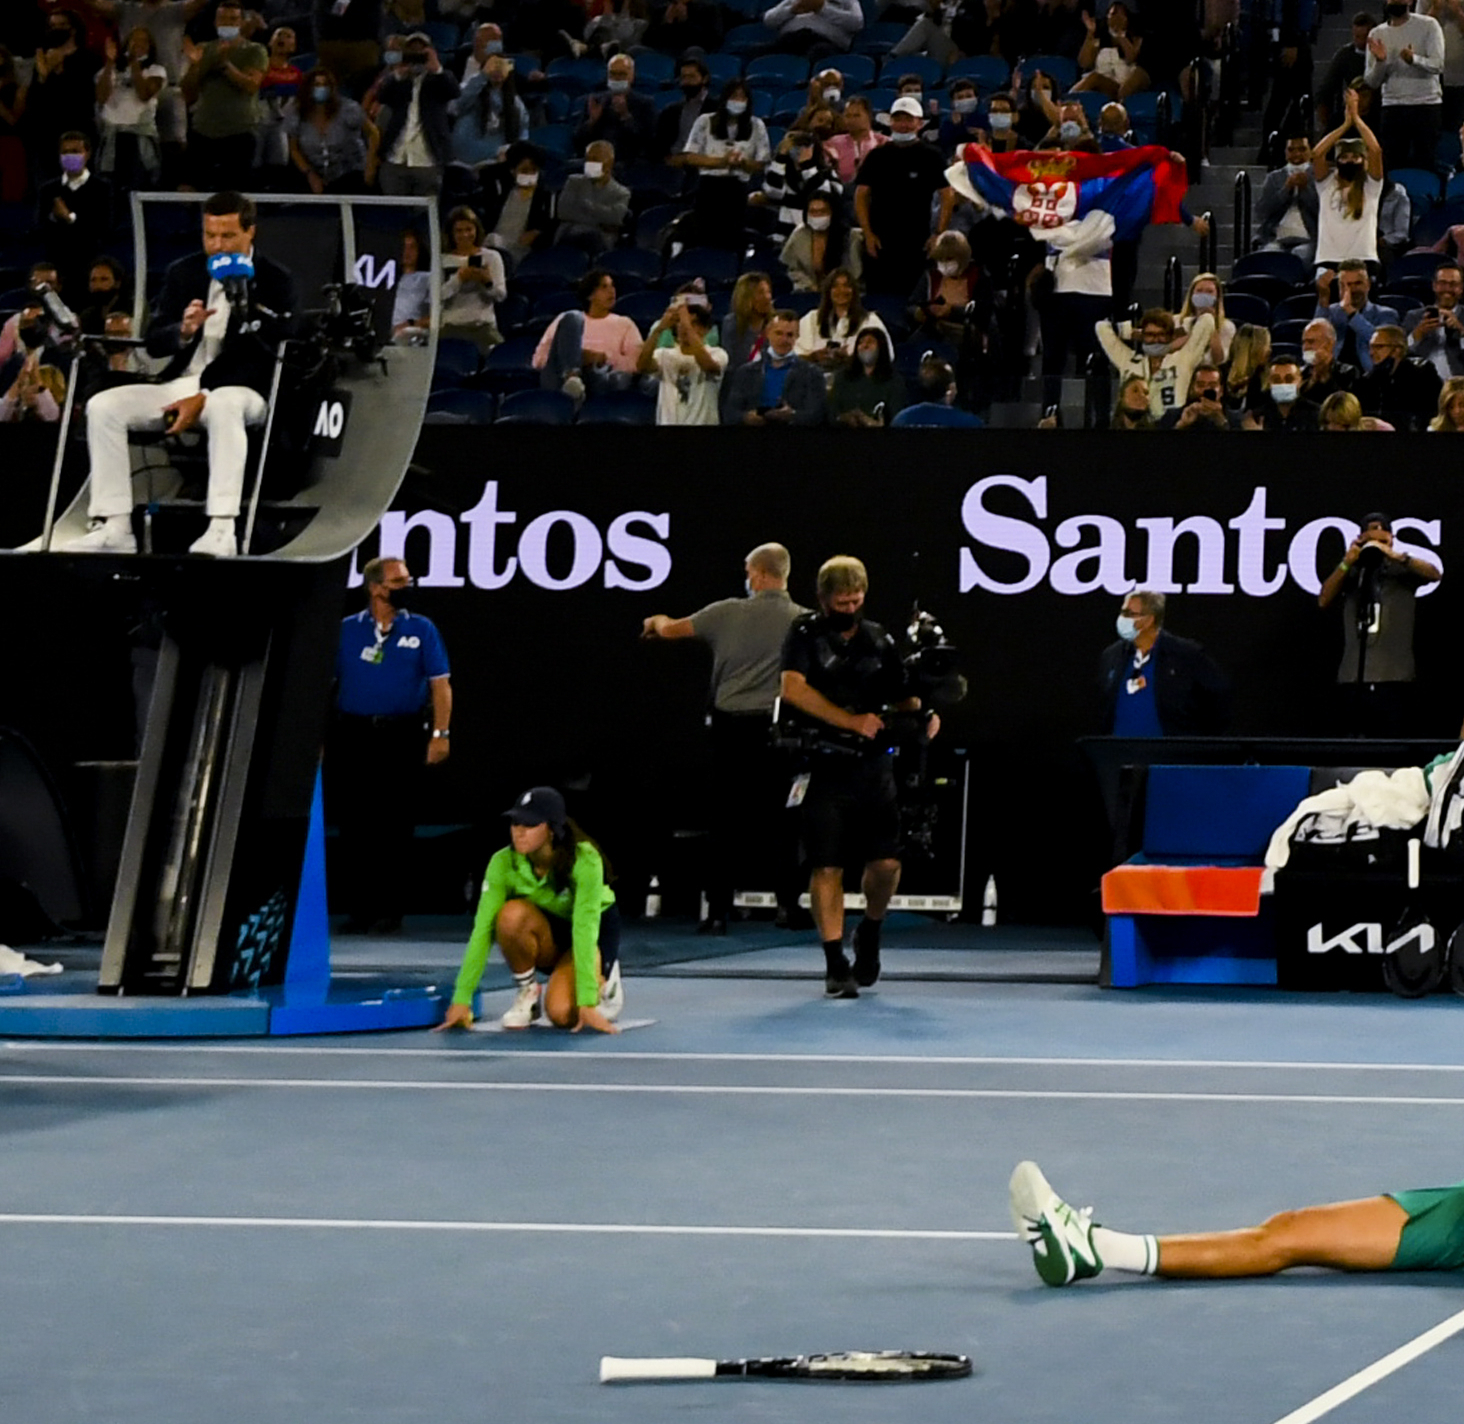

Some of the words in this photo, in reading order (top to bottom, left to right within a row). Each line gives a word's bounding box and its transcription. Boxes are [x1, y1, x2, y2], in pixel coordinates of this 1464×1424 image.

[313, 400, 344, 439] AO
[347, 480, 672, 591] ntos
[959, 474, 1444, 597] Santos
[397, 636, 420, 649] AO
[1307, 922, 1435, 954] KIA
